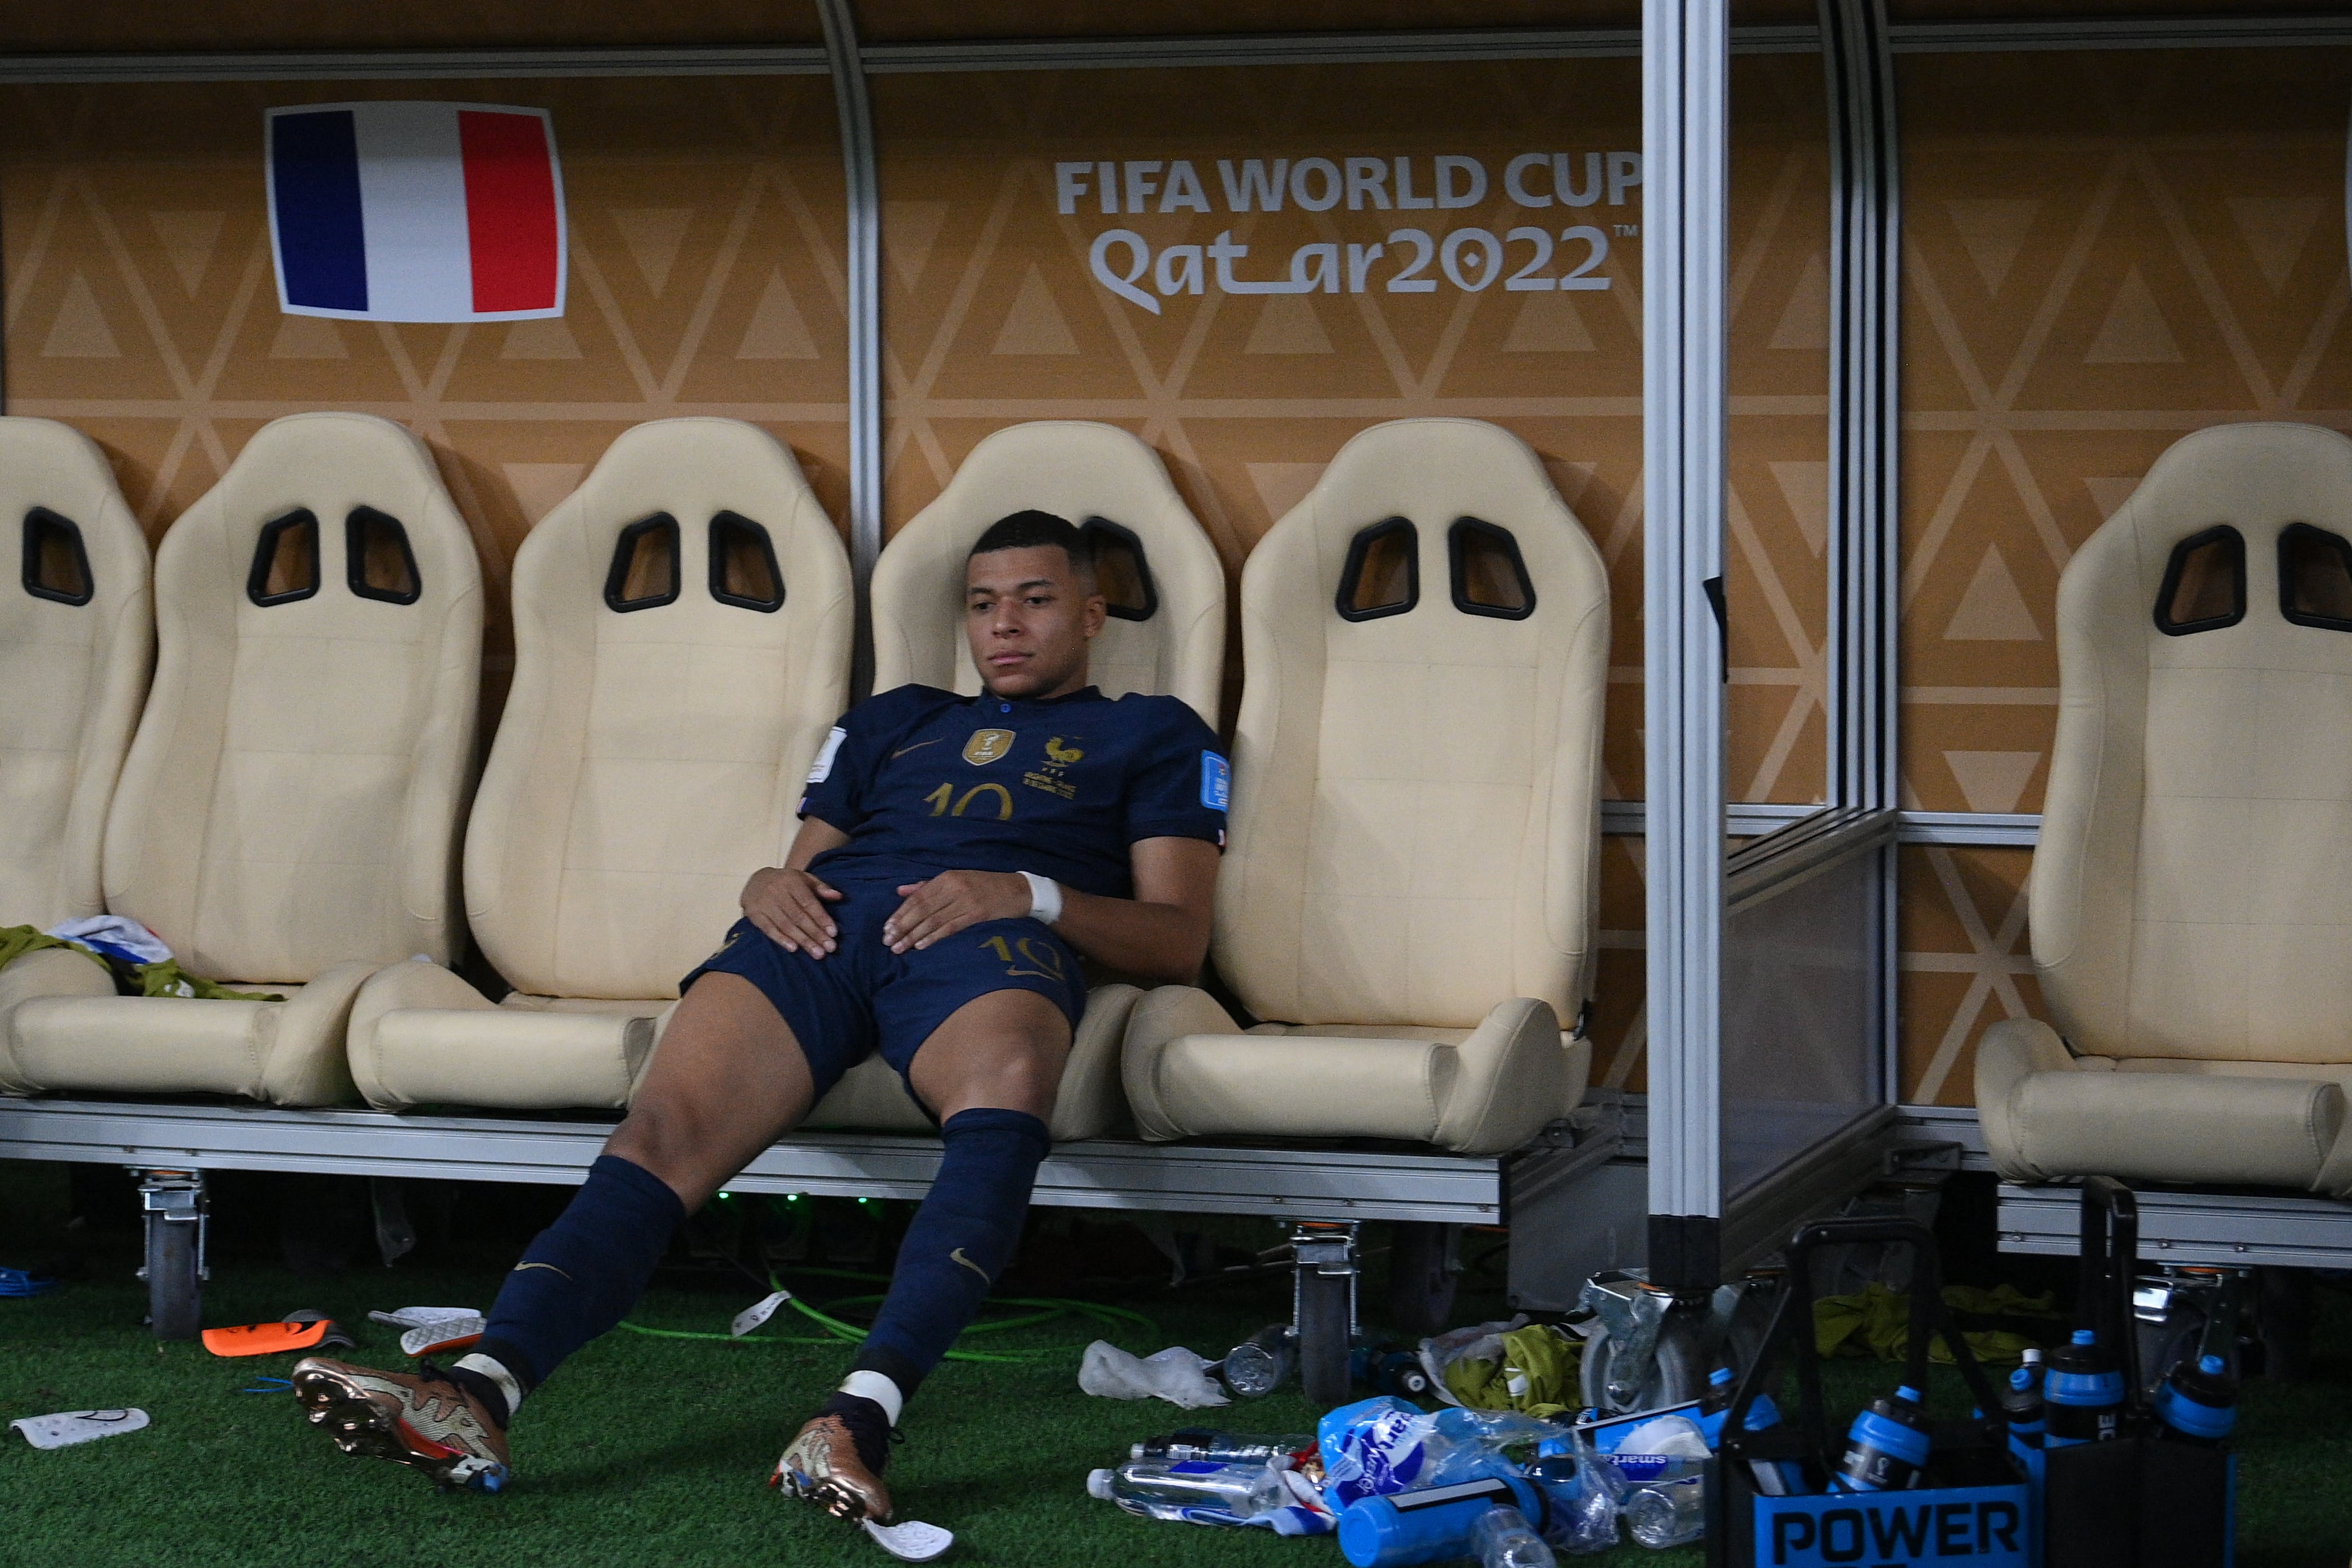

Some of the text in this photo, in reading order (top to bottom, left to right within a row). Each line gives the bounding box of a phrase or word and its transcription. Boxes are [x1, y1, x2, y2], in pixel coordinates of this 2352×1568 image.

[1055, 152, 1643, 215] FIFA WORLD CUP
[922, 782, 1013, 821] 10
[1773, 1500, 2020, 1565] POWER
